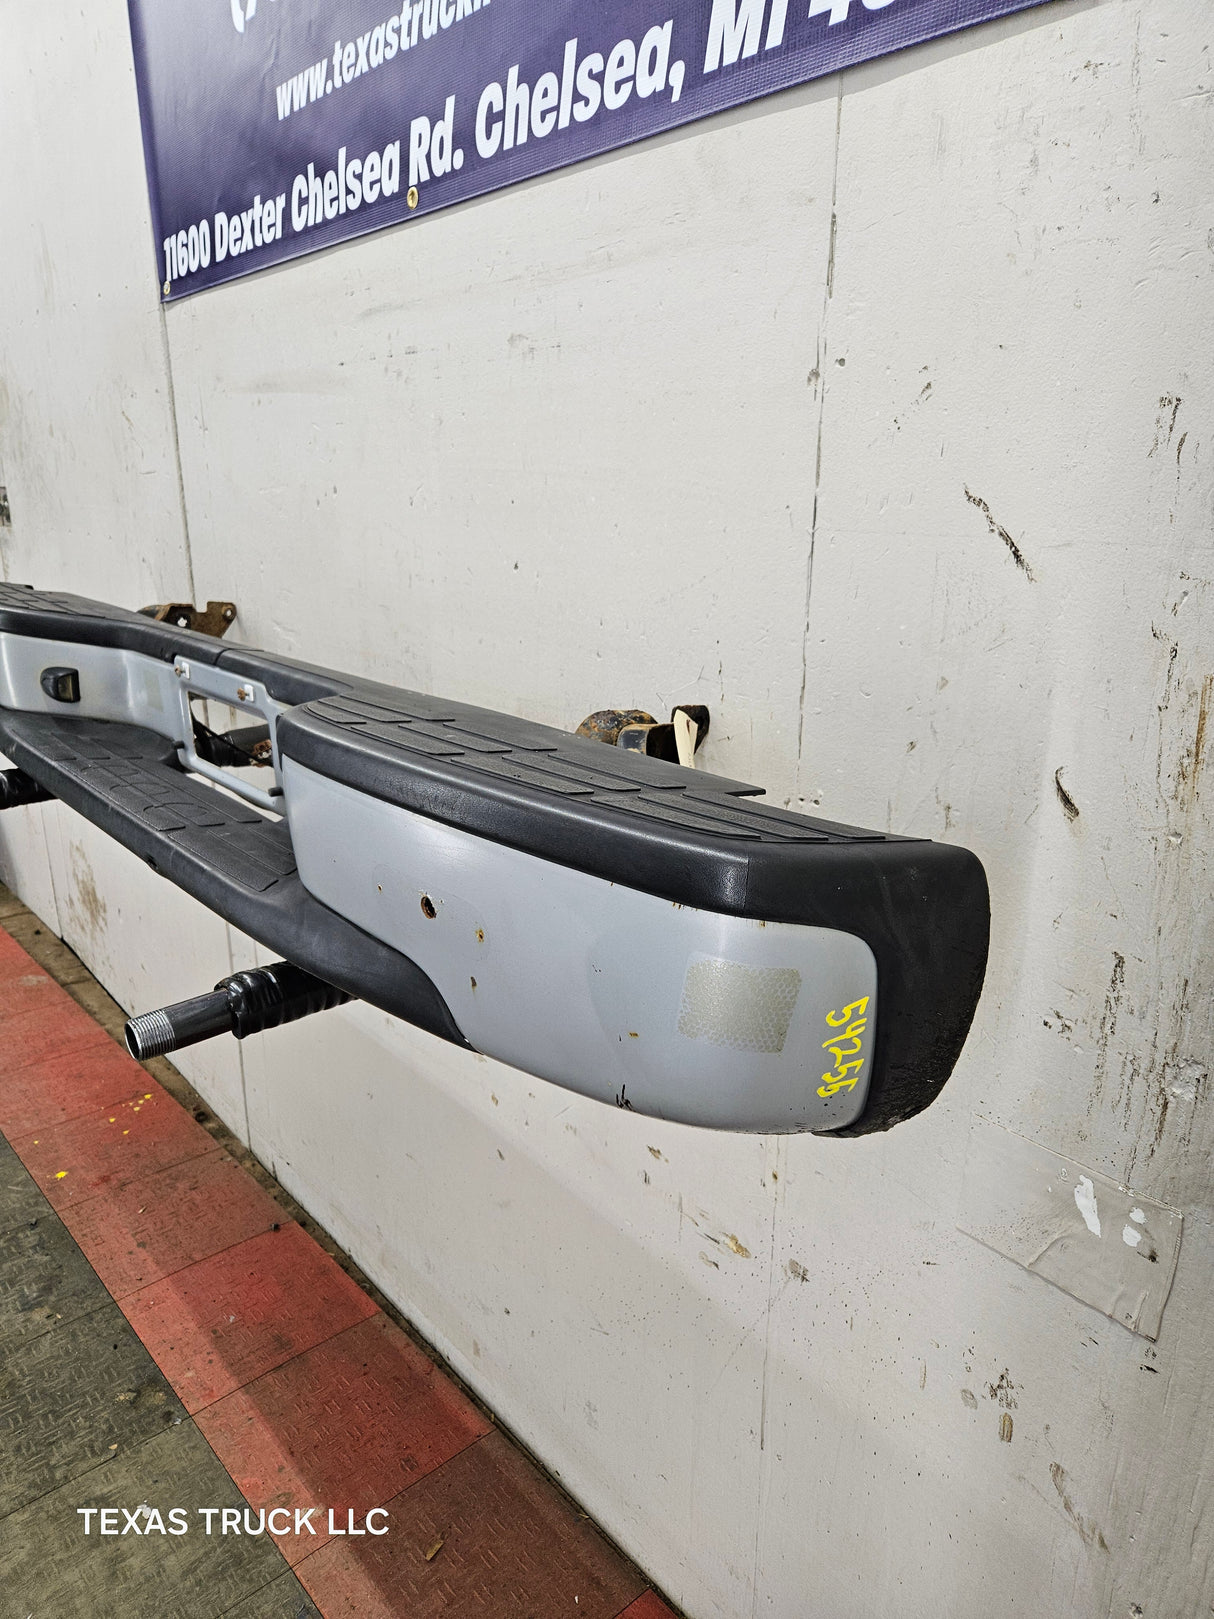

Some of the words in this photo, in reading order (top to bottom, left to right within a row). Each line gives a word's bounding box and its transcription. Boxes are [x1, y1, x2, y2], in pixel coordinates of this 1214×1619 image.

[163, 219, 211, 281] 11600
[214, 193, 286, 262] Dexter
[291, 139, 400, 232] Chelsea
[409, 95, 464, 187] Rd.
[475, 19, 686, 159] Chelsea,
[276, 0, 490, 120] www.texastruc
